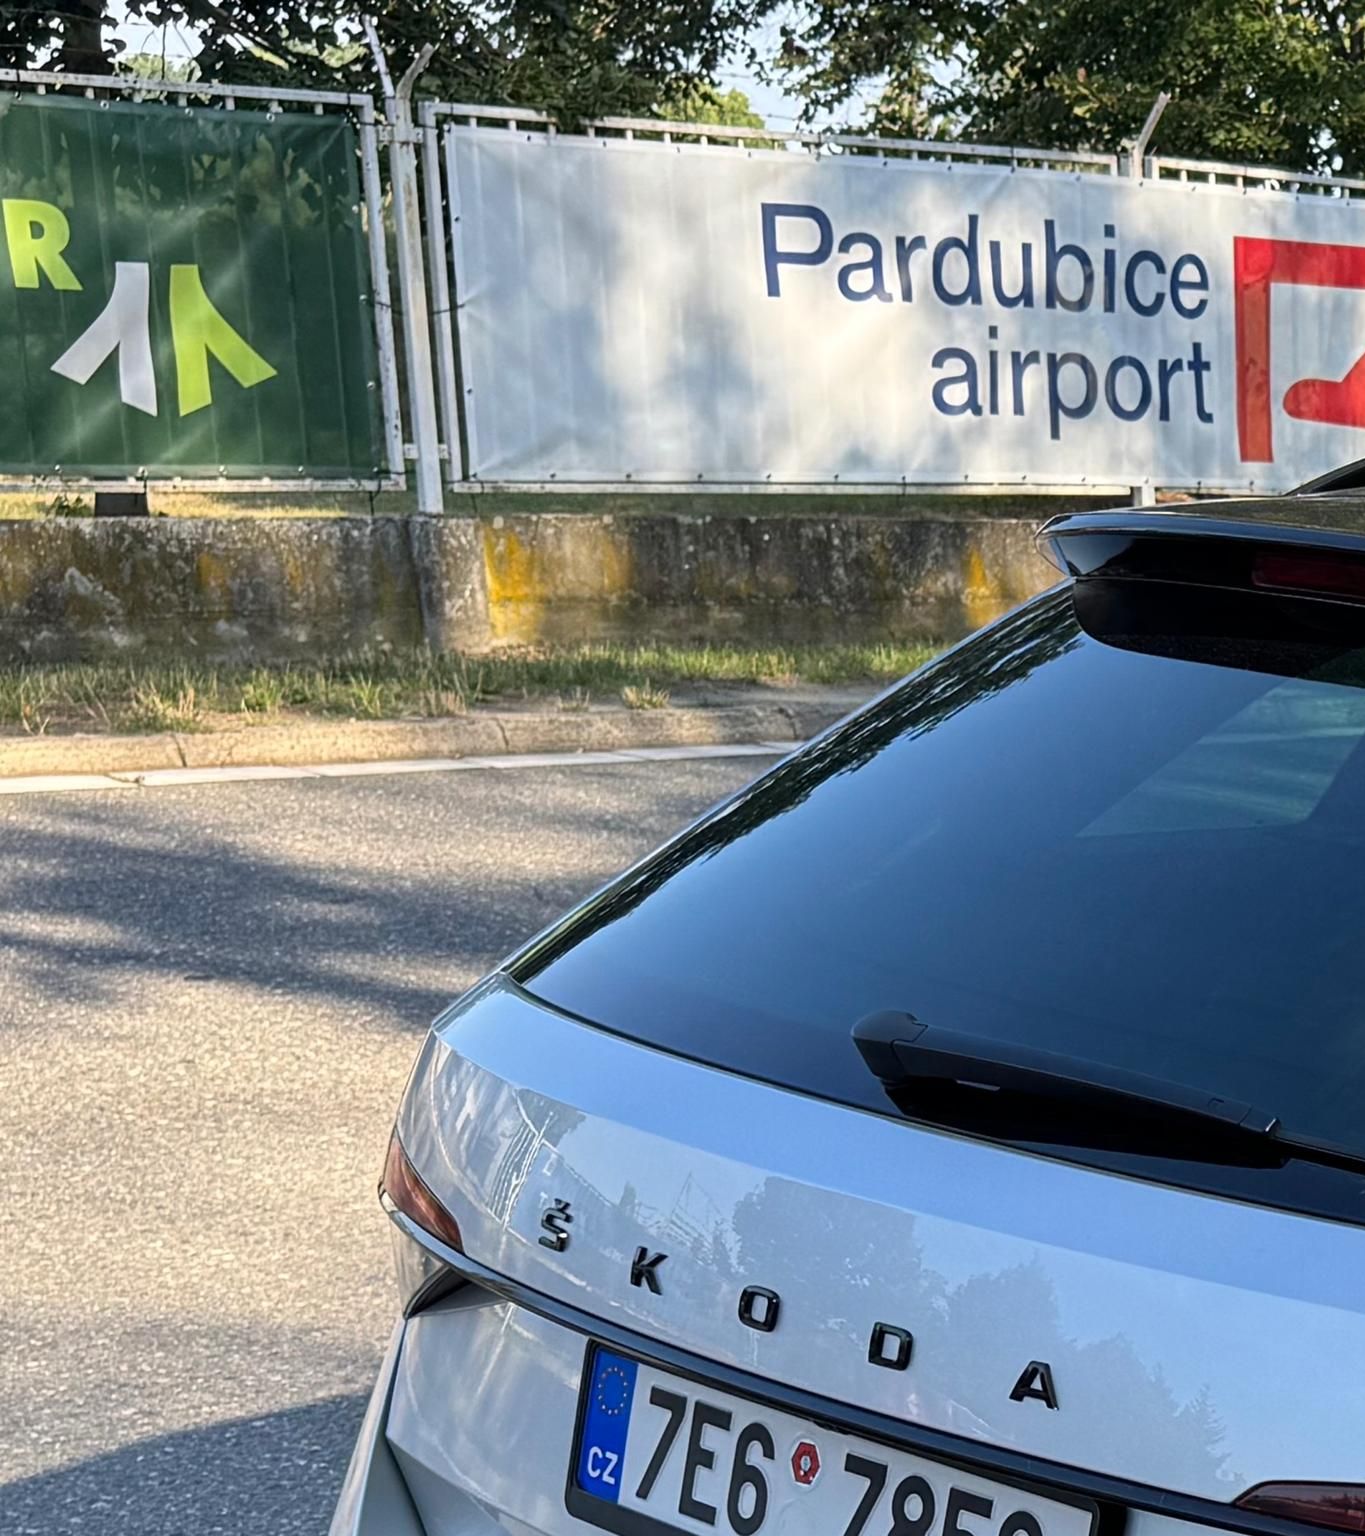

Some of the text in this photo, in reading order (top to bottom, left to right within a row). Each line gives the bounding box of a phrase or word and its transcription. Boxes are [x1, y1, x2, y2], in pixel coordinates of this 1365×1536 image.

[2, 198, 84, 291] R
[760, 201, 1211, 321] Pardubice
[930, 325, 1215, 441] airport
[537, 1198, 1061, 1412] ŠKODA
[586, 1445, 620, 1486] CZ
